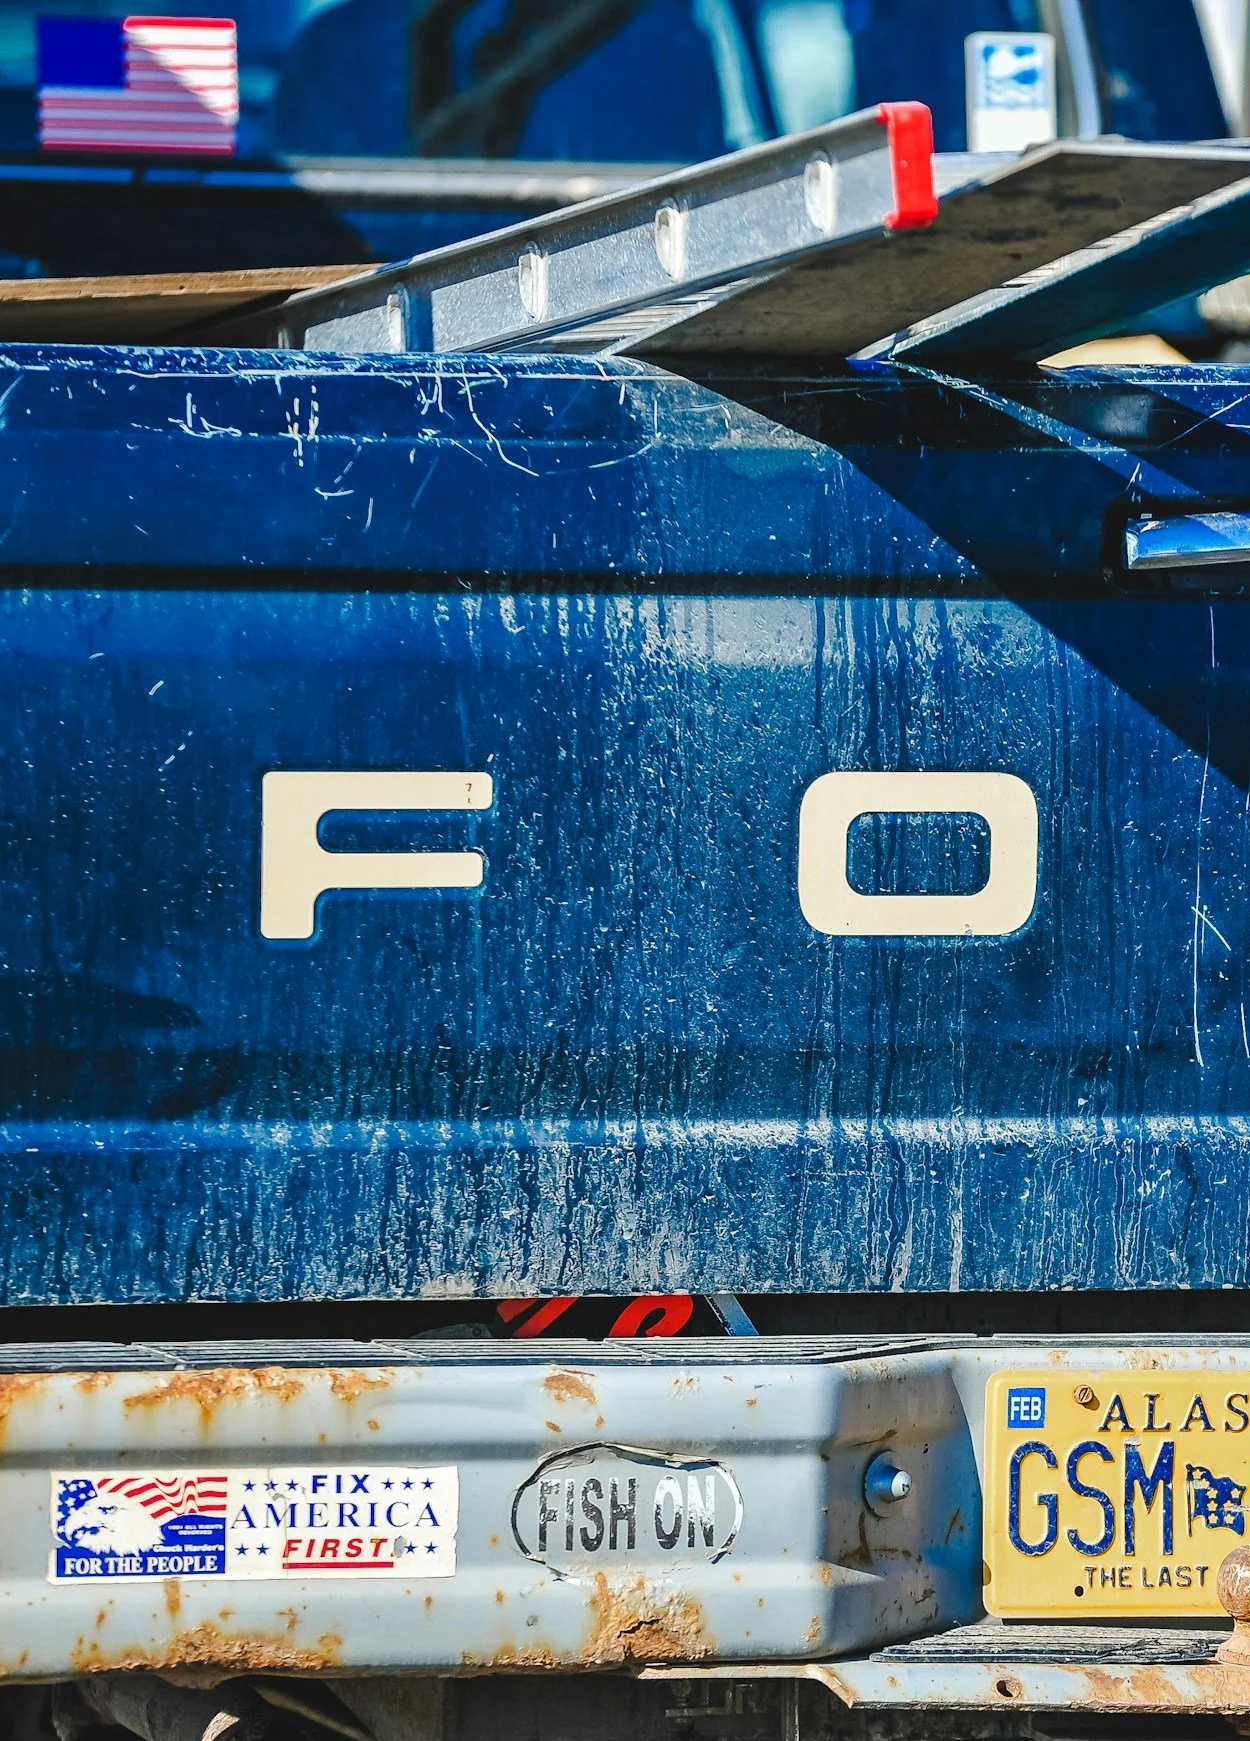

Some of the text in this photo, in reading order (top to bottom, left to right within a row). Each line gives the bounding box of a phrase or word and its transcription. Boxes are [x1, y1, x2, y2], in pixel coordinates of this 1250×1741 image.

[1010, 1396, 1042, 1421] FEB
[312, 1474, 371, 1494] FIX
[1008, 1440, 1175, 1557] GSM
[231, 1501, 441, 1529] AMERICA
[538, 1475, 716, 1552] FISH ON
[64, 1555, 218, 1575] FOR THE PEOPLE
[1084, 1566, 1209, 1589] THE LAST
